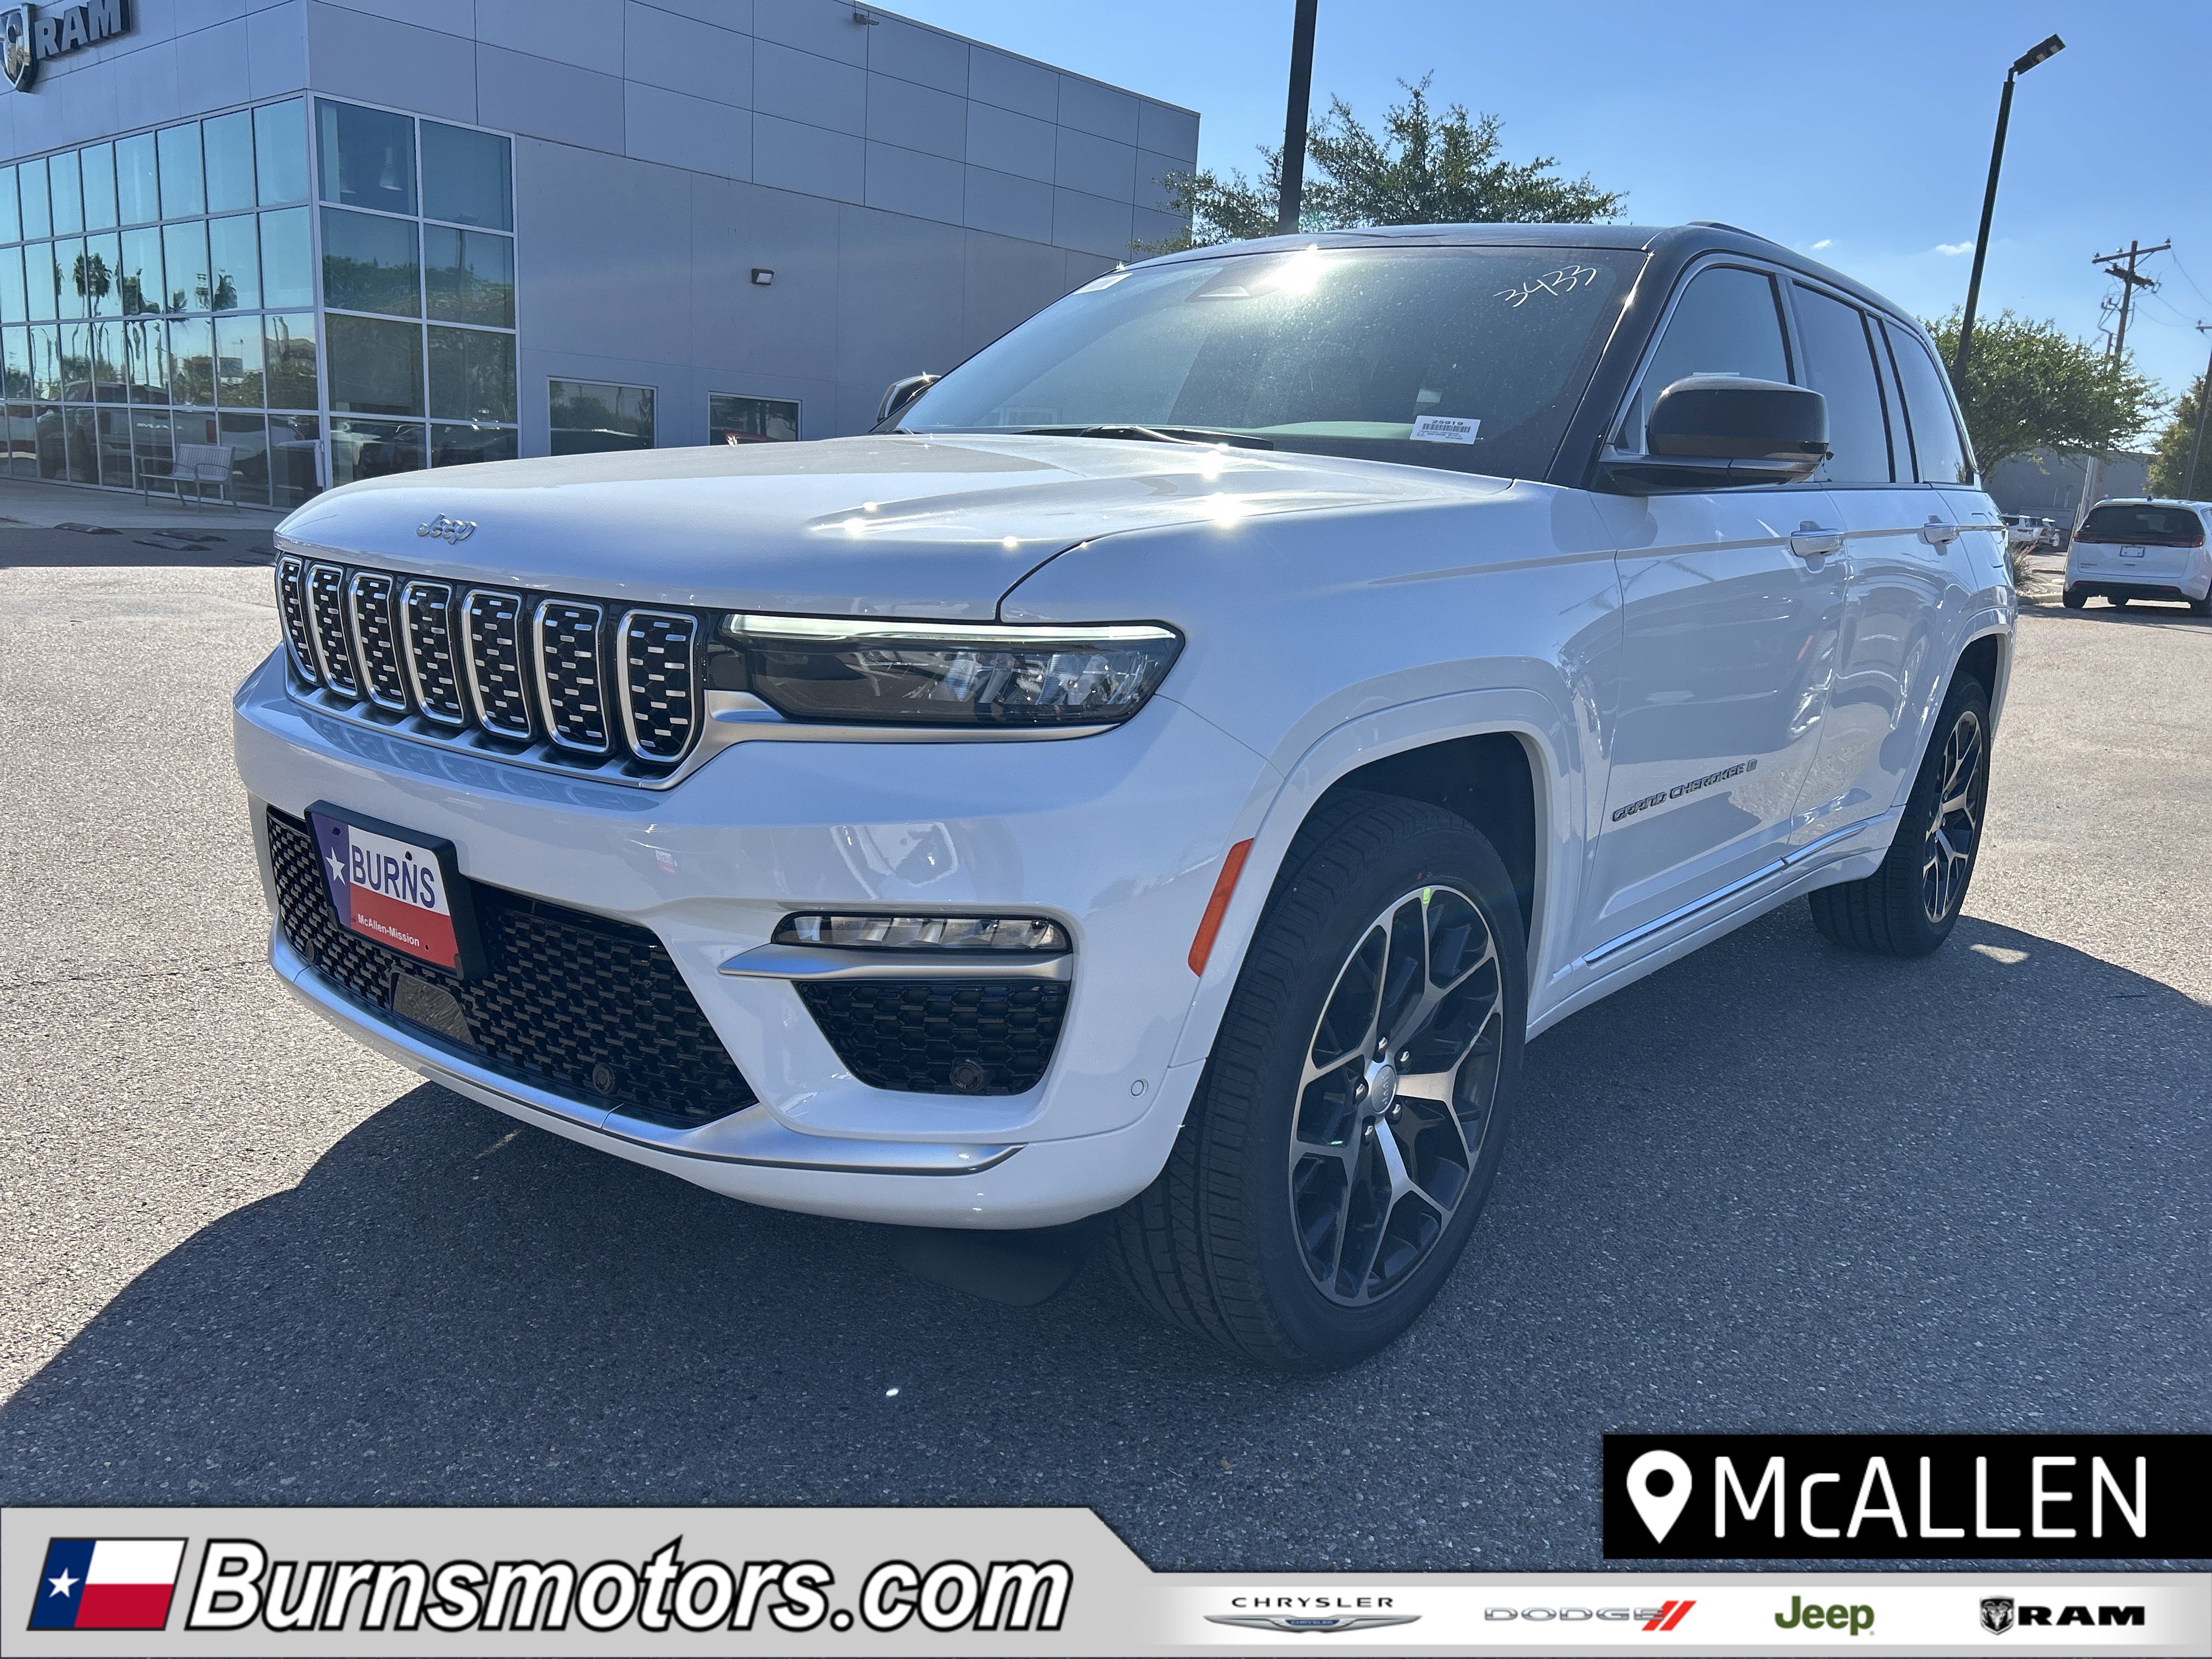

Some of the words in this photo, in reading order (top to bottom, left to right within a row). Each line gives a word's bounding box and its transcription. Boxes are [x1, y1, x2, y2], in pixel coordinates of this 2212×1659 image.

[34, 0, 122, 59] RAM
[1492, 266, 1596, 307] 3433
[416, 512, 477, 545] Jeep
[1612, 792, 1667, 822] GRAND
[1669, 763, 1746, 799] CHEROKEE
[352, 845, 435, 909] BURNS
[358, 913, 420, 947] McAllen-Mission
